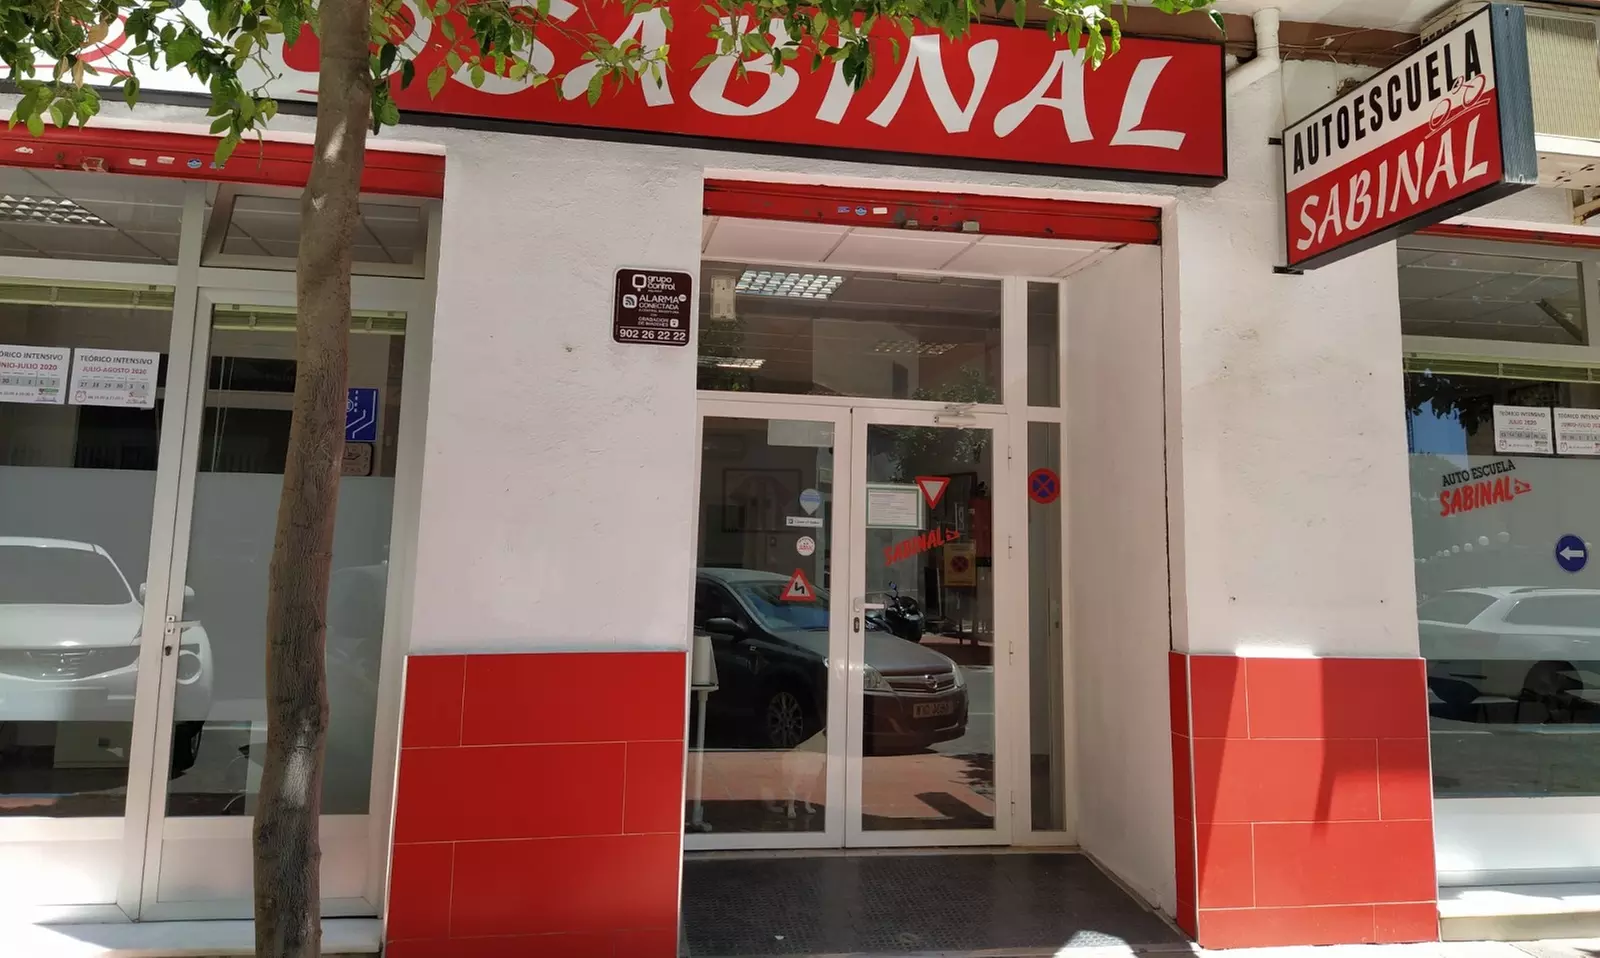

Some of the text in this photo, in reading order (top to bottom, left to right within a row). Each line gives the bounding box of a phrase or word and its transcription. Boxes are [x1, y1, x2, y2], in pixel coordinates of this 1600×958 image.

[450, 0, 1186, 152] SABINAL
[1293, 29, 1483, 175] AUTOESCUELA
[1296, 113, 1490, 251] SABINAL
[647, 275, 673, 284] grupo
[647, 283, 676, 291] control
[639, 294, 680, 304] ALARMA
[638, 302, 680, 310] CONECTADA
[619, 328, 686, 341] 902 26 22 22
[23, 352, 64, 361] INTENSIVO
[80, 354, 153, 365] TEÓRICO INTENSIVO
[39, 363, 58, 371] 2020
[82, 366, 147, 375] JULIO-AGOSTO 2020
[1442, 459, 1516, 488] AUTO ESCUELA
[1440, 475, 1515, 518] SABINAL
[883, 527, 946, 568] SABINAL
